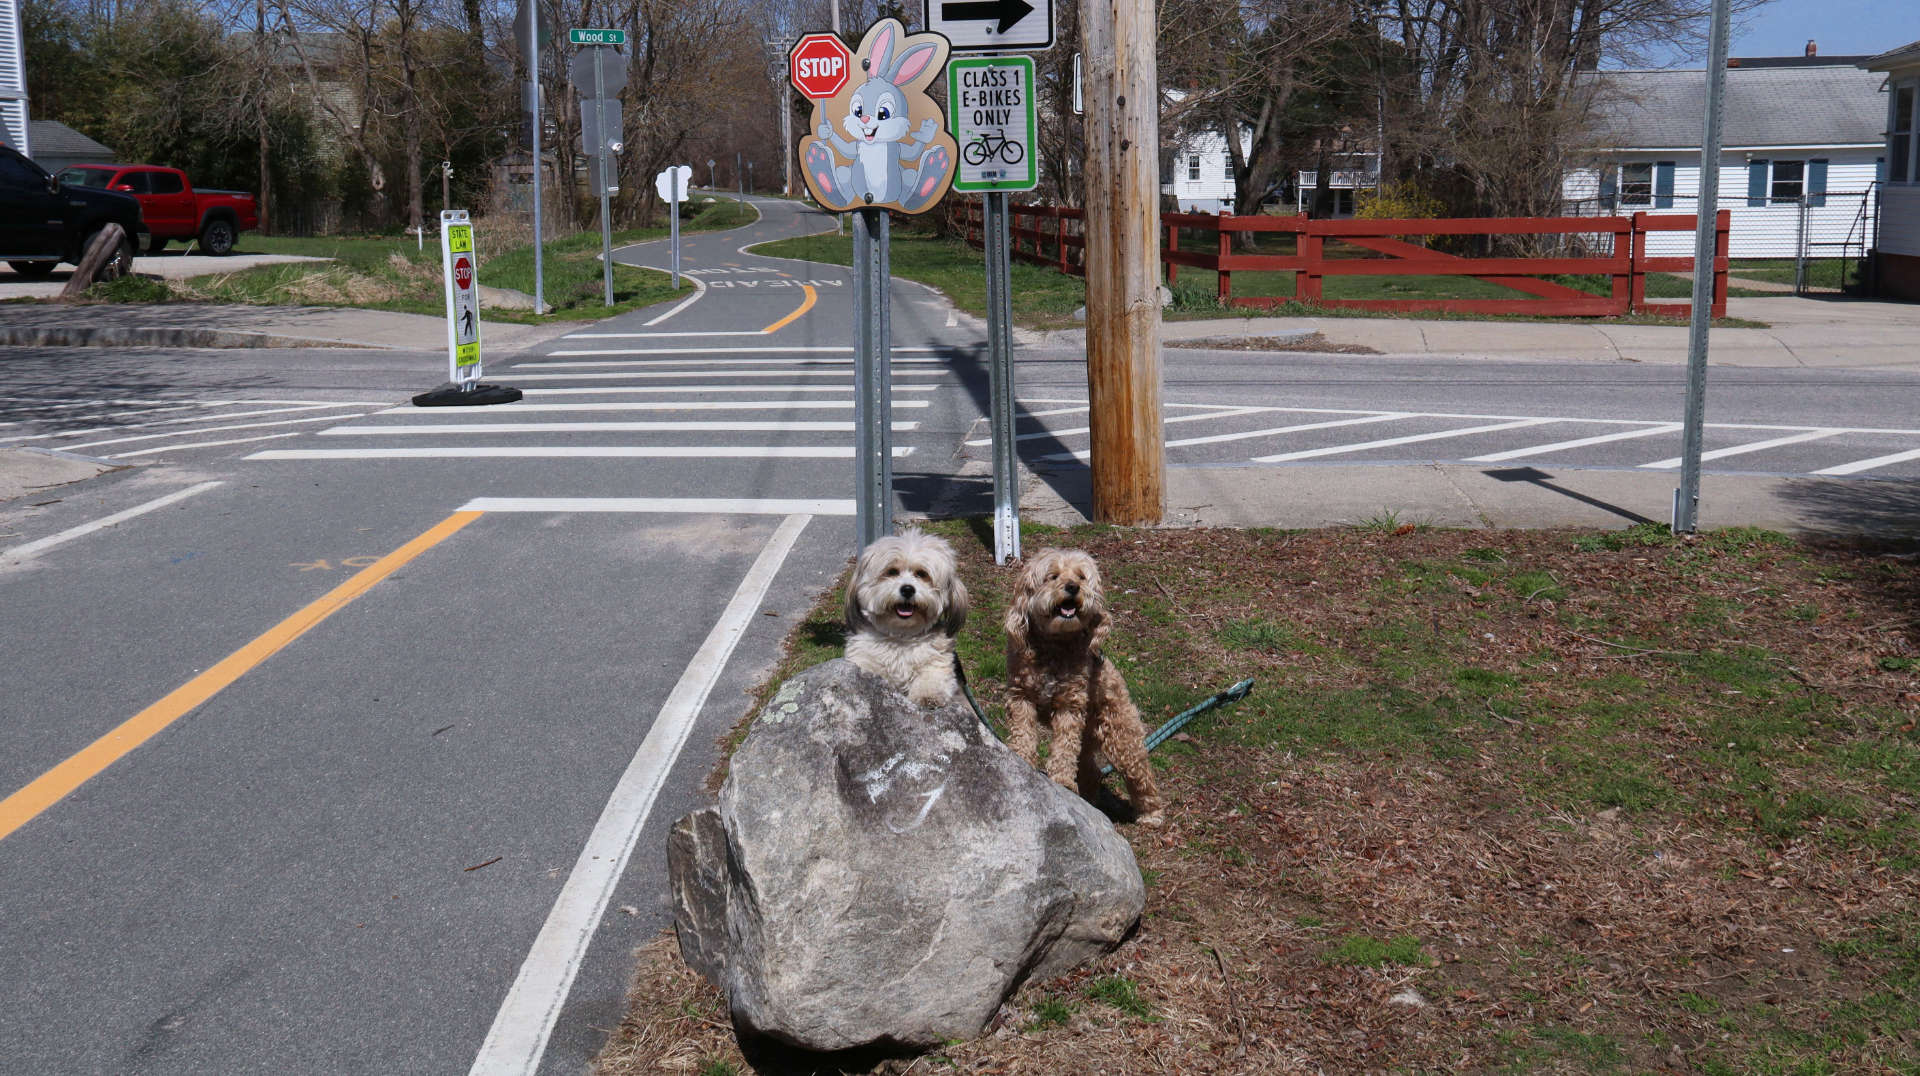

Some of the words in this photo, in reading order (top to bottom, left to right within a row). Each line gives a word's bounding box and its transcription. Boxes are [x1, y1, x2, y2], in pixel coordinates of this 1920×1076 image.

[578, 31, 604, 42] Wood
[608, 33, 617, 42] St
[799, 56, 843, 78] STOP
[963, 70, 1007, 88] CLASS
[1013, 69, 1020, 86] 1
[963, 89, 1021, 108] E-BIKES
[973, 109, 1012, 126] ONLY
[451, 229, 469, 239] STATE
[455, 267, 472, 281] STOP
[709, 280, 843, 288] AHEAD
